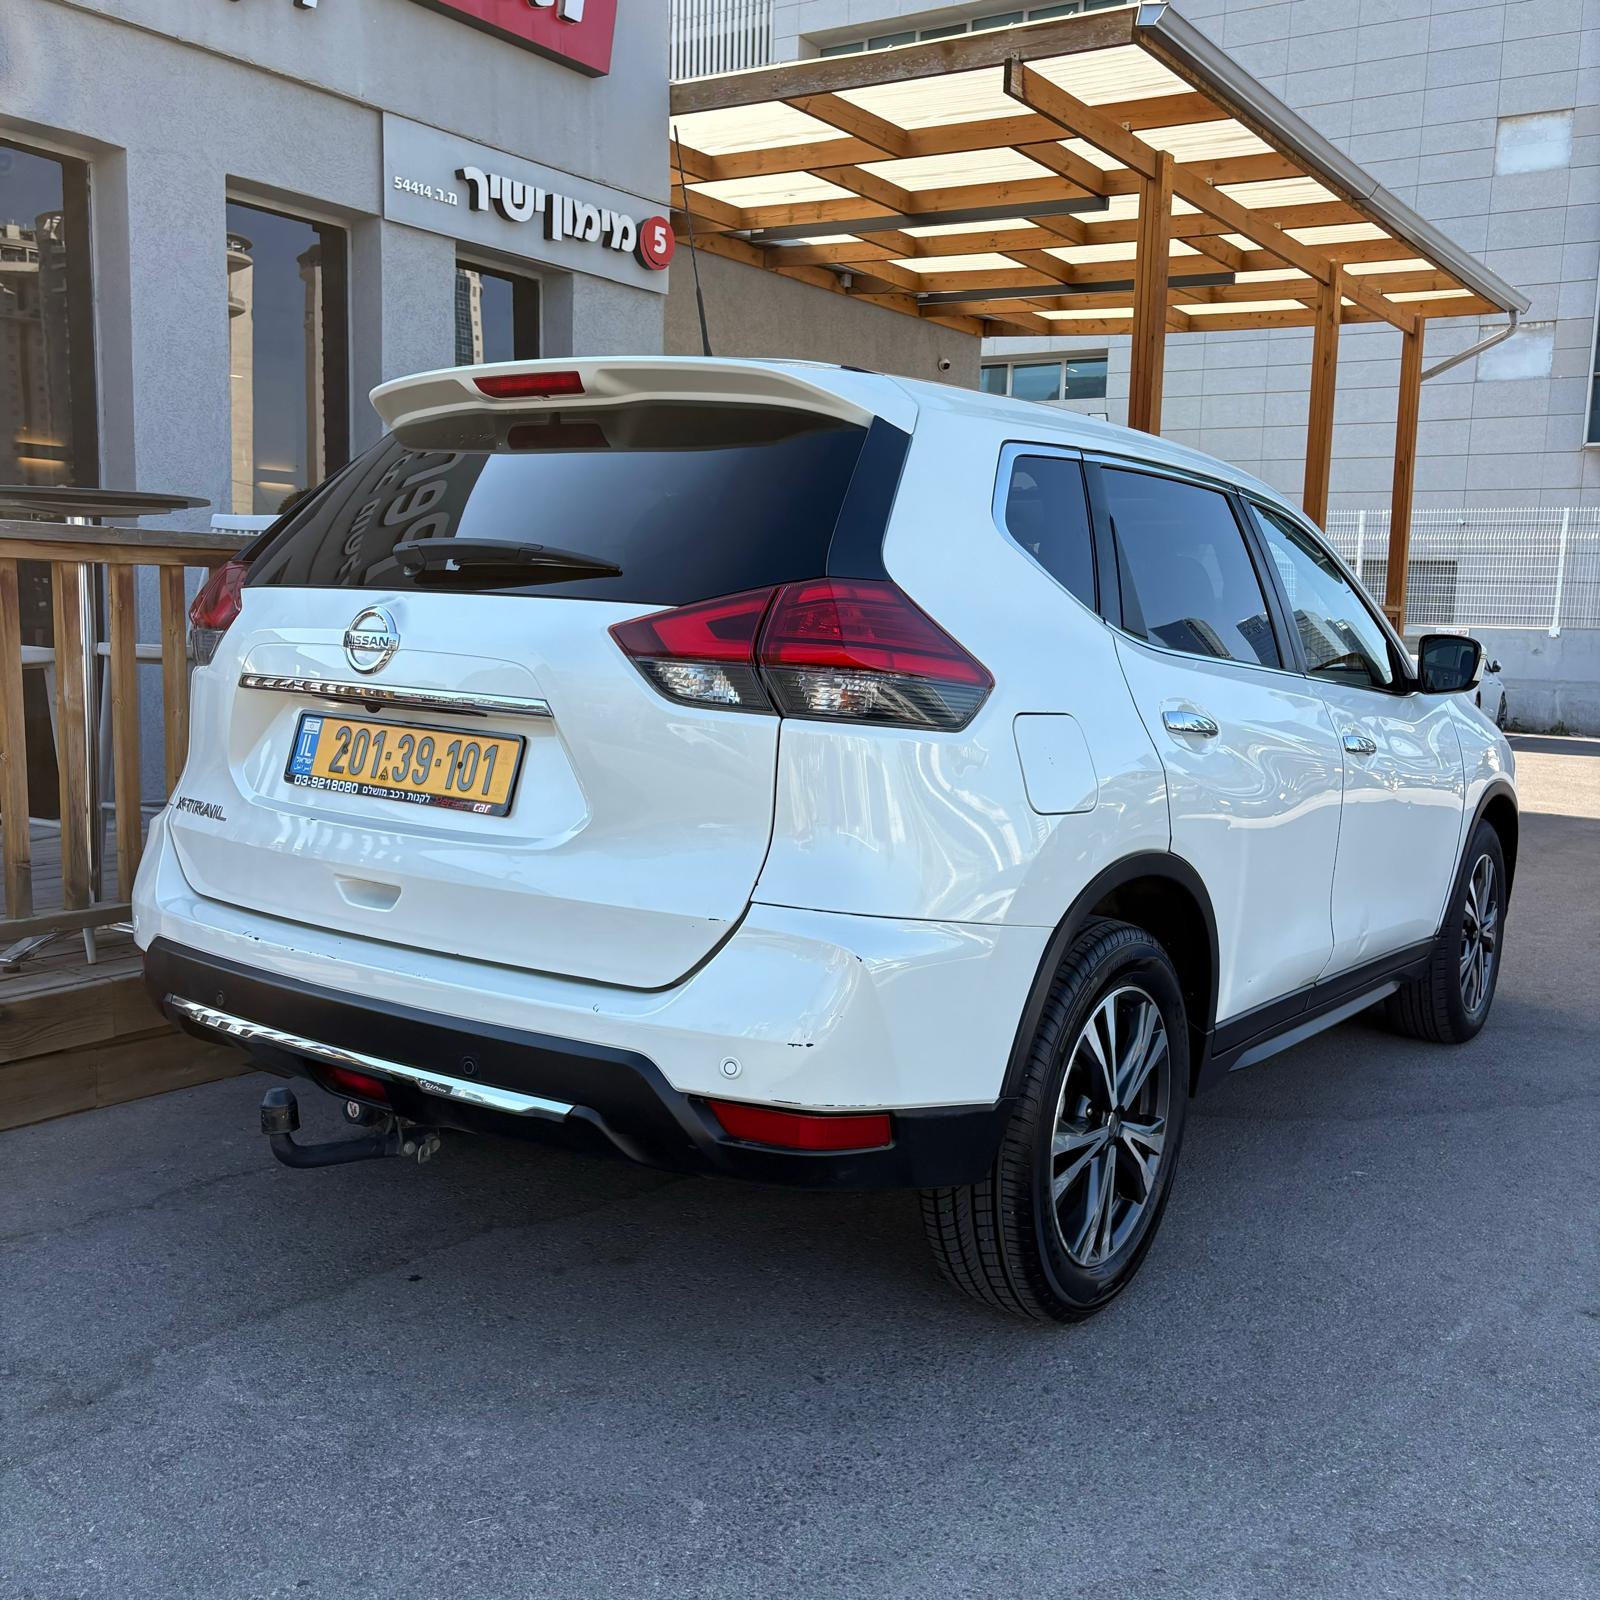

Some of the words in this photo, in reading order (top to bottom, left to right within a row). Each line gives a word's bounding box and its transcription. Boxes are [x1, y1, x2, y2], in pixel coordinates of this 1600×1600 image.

[394, 175, 432, 198] 54414
[456, 165, 546, 223] ישיר
[543, 193, 638, 254] מימון
[653, 225, 667, 254] 5
[344, 633, 389, 647] NISSAN
[300, 734, 312, 757] IL
[362, 784, 388, 797] מושלם
[389, 789, 405, 800] רכב
[406, 792, 431, 804] לקנות
[176, 796, 227, 822] X-TRAIL
[472, 802, 492, 814] car
